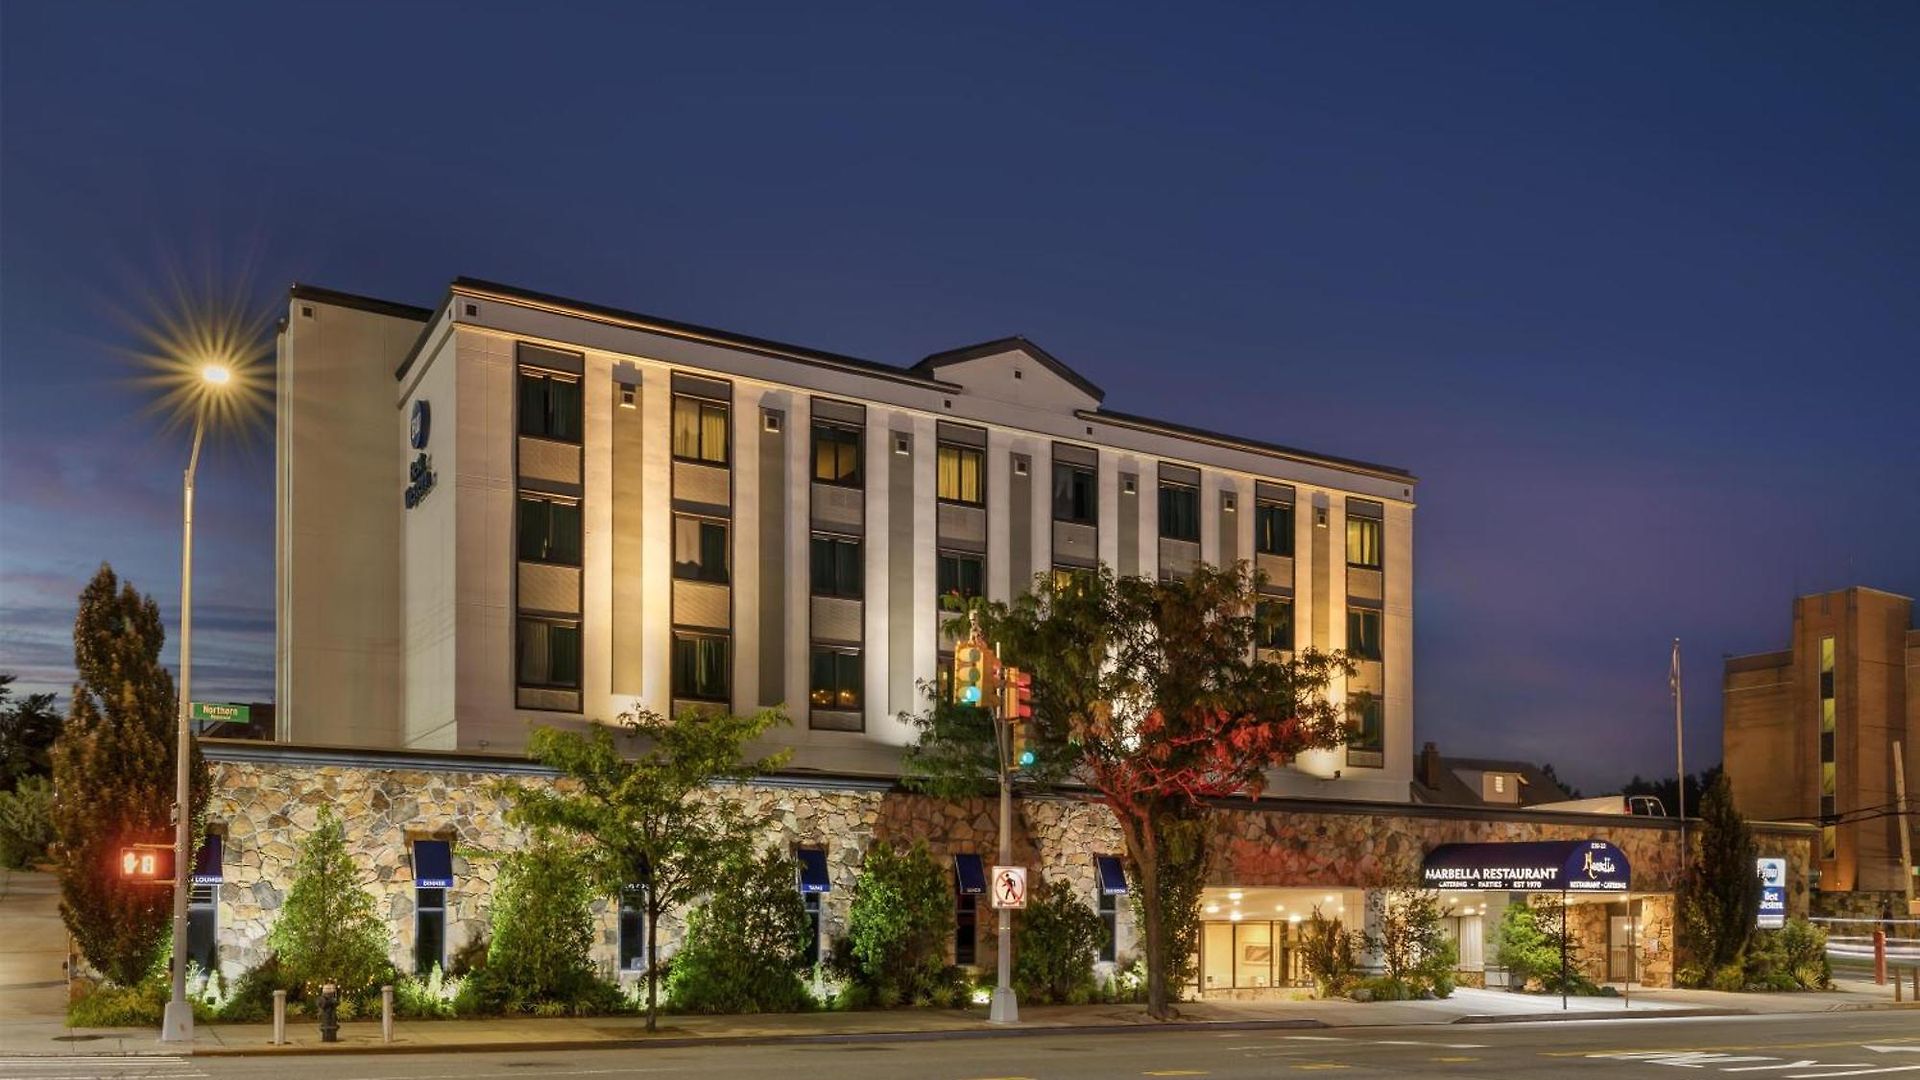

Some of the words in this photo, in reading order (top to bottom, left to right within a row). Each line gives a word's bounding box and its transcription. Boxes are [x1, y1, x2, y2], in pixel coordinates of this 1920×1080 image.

[203, 704, 238, 717] Northern
[1425, 868, 1480, 879] MARBELLA
[1483, 867, 1558, 880] RESTAURANT
[1438, 880, 1468, 888] CATERING
